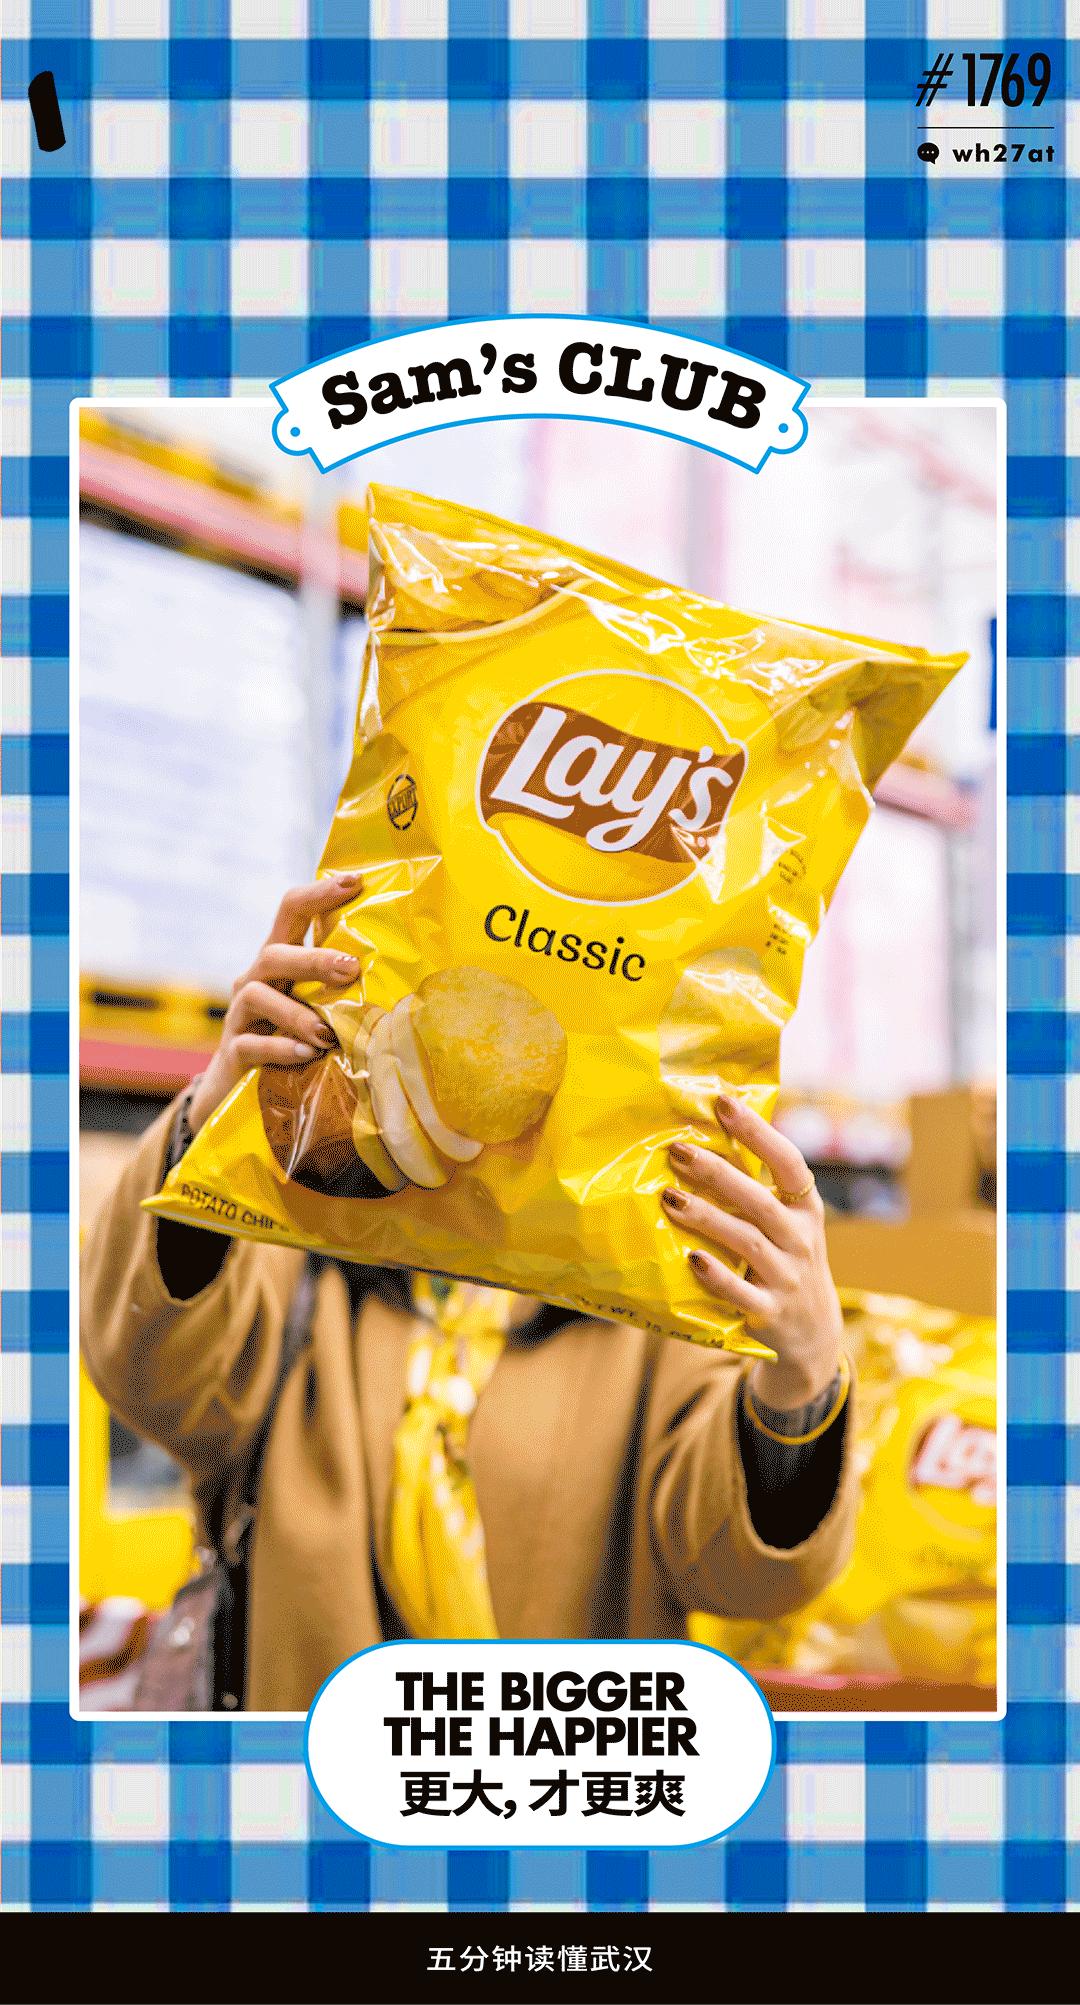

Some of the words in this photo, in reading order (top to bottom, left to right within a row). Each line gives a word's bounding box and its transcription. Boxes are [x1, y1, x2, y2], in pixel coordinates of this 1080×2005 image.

[490, 706, 734, 852] Lay's
[484, 904, 646, 982] Classic
[181, 1183, 238, 1220] POTATO
